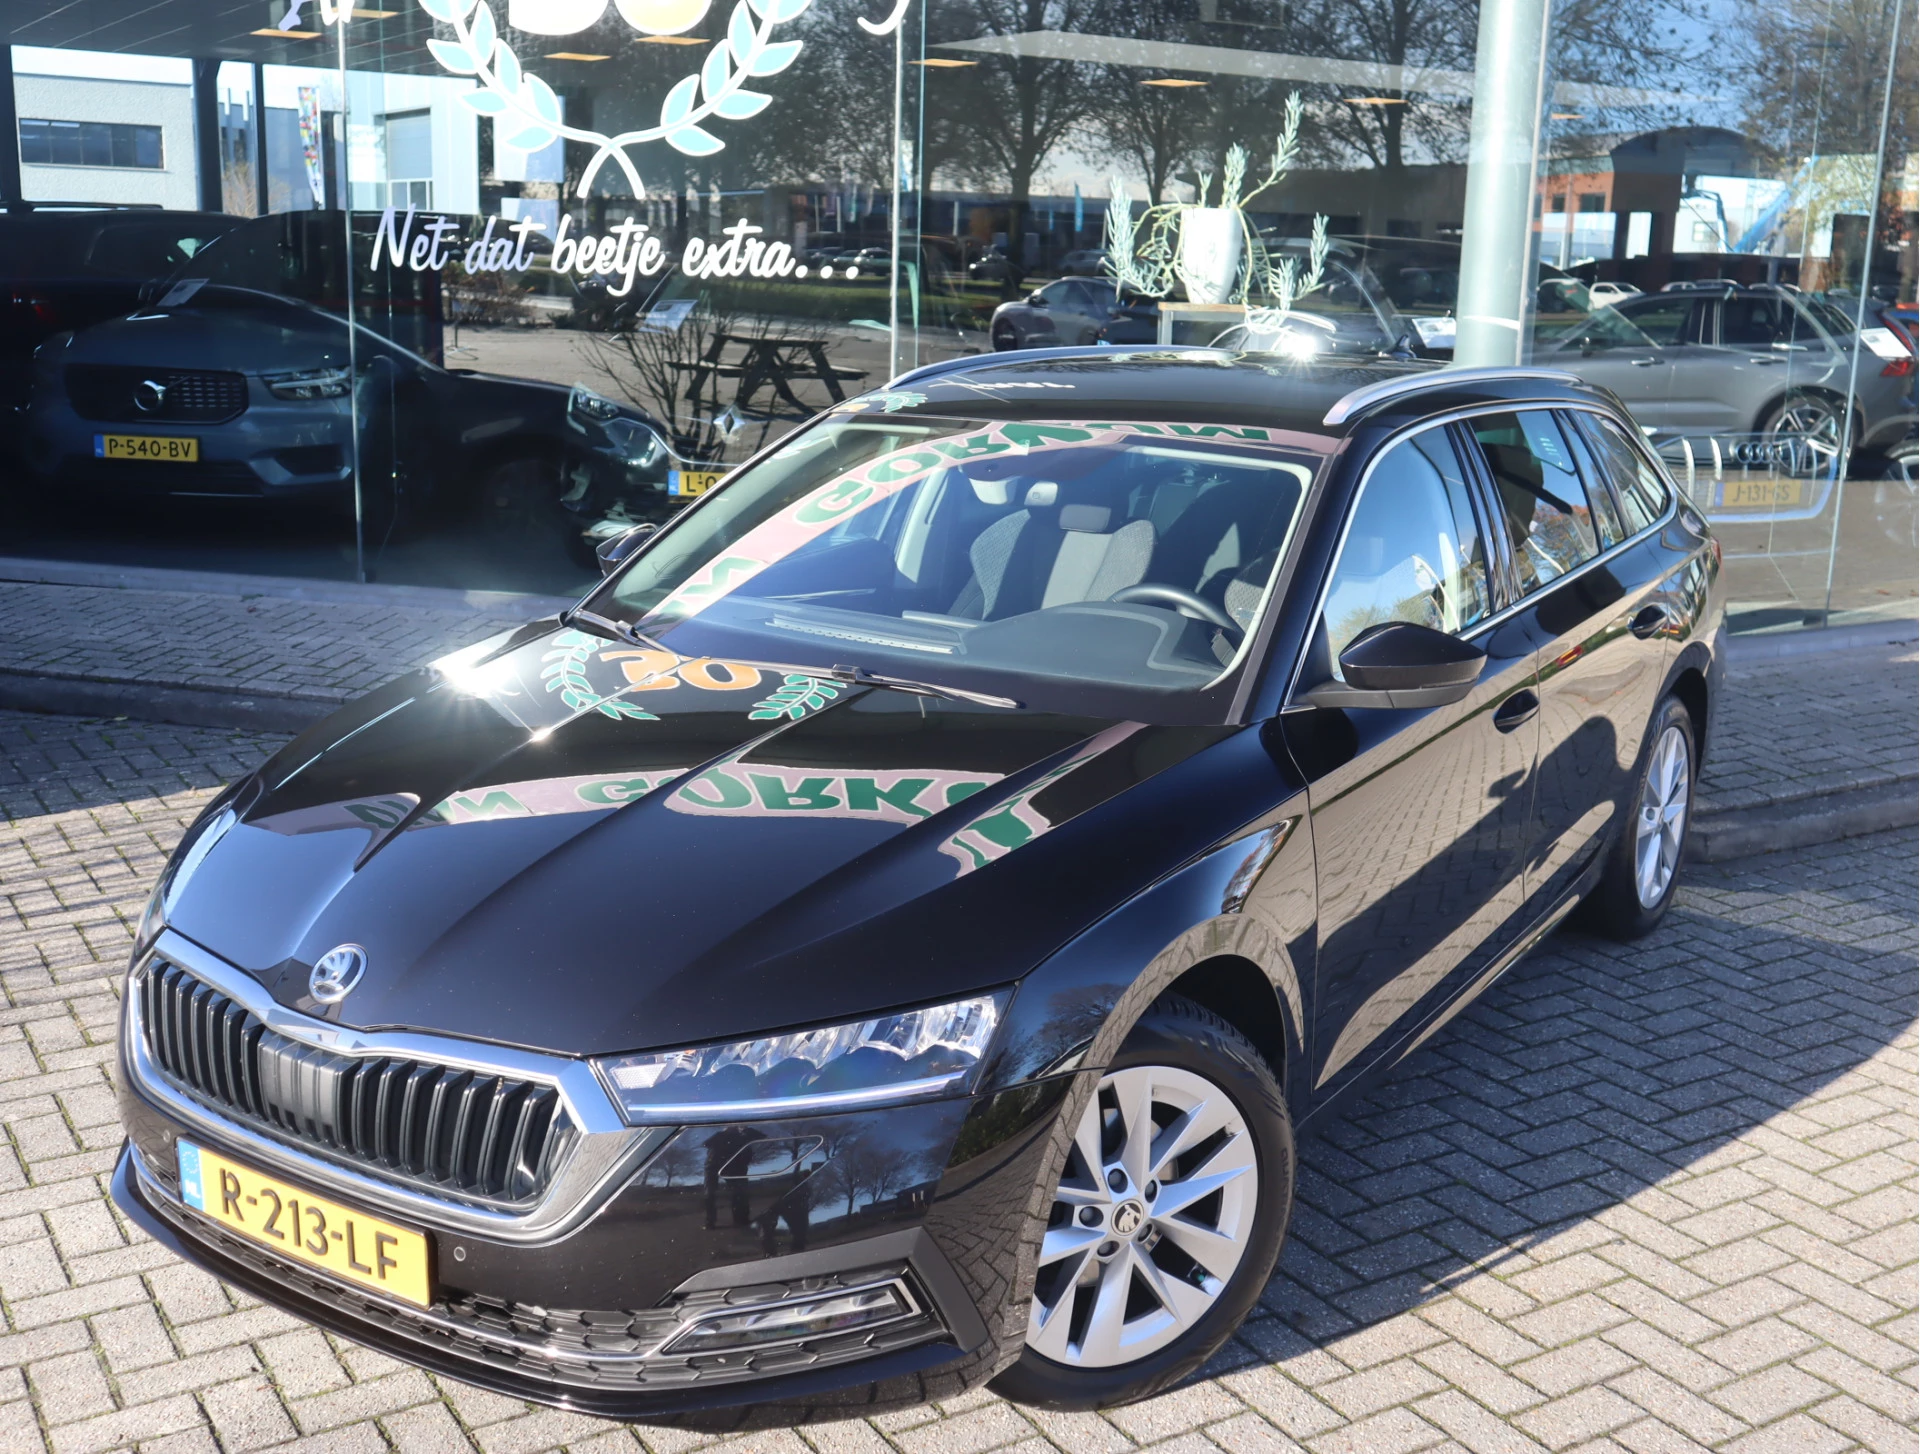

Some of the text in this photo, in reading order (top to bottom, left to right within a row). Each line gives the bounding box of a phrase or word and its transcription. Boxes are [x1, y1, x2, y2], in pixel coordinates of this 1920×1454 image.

[370, 203, 461, 272] Net
[464, 214, 547, 275] dat
[550, 212, 667, 297] beetje
[108, 438, 191, 458] P-540-BV
[1732, 483, 1791, 503] J-131-GS
[219, 1167, 398, 1281] R-213-LF
